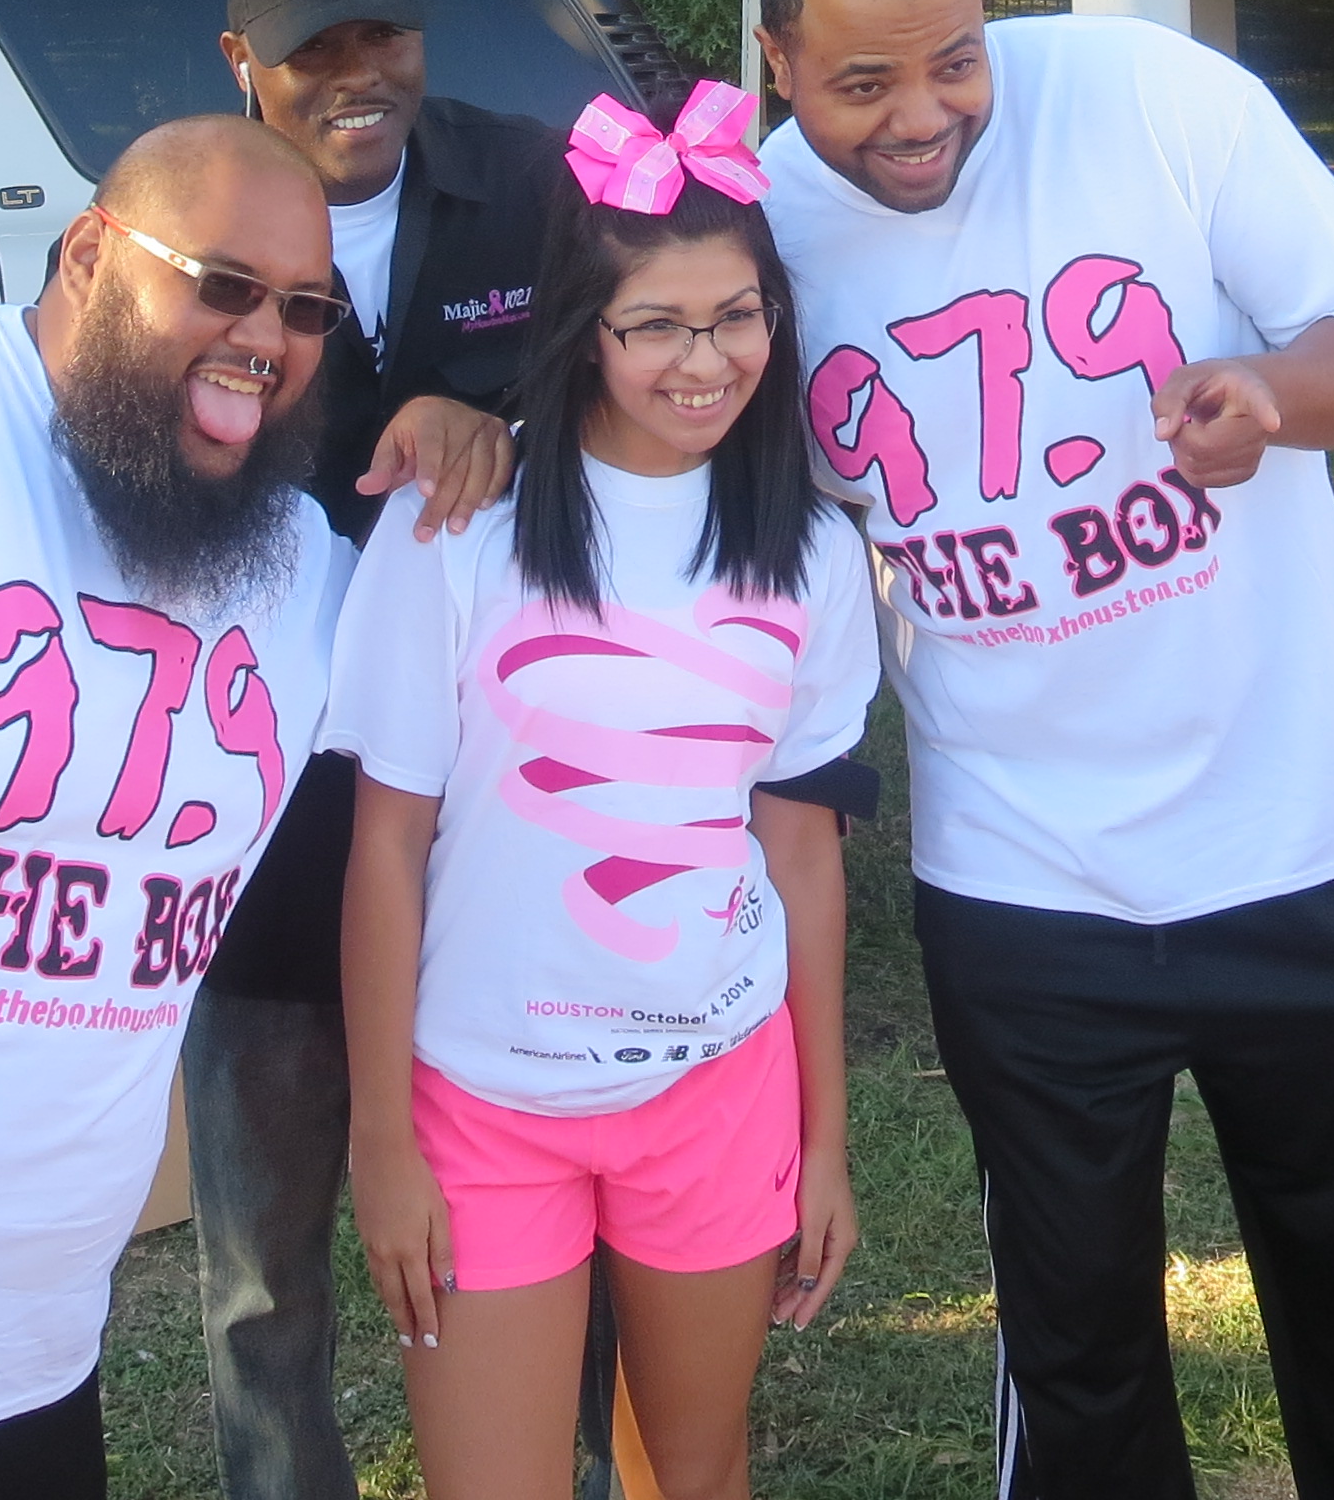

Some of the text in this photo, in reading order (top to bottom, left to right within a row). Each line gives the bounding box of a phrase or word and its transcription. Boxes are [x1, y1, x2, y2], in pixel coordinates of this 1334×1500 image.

[0, 189, 41, 206] LT
[442, 299, 488, 321] Majic
[807, 254, 1192, 527] 97.9
[1047, 465, 1223, 599] BOX
[525, 1000, 624, 1018] HOUSTON
[630, 1009, 708, 1025] October
[720, 975, 756, 1008] 2014
[509, 1045, 587, 1062] American Airlines
[618, 1049, 647, 1062] Ford
